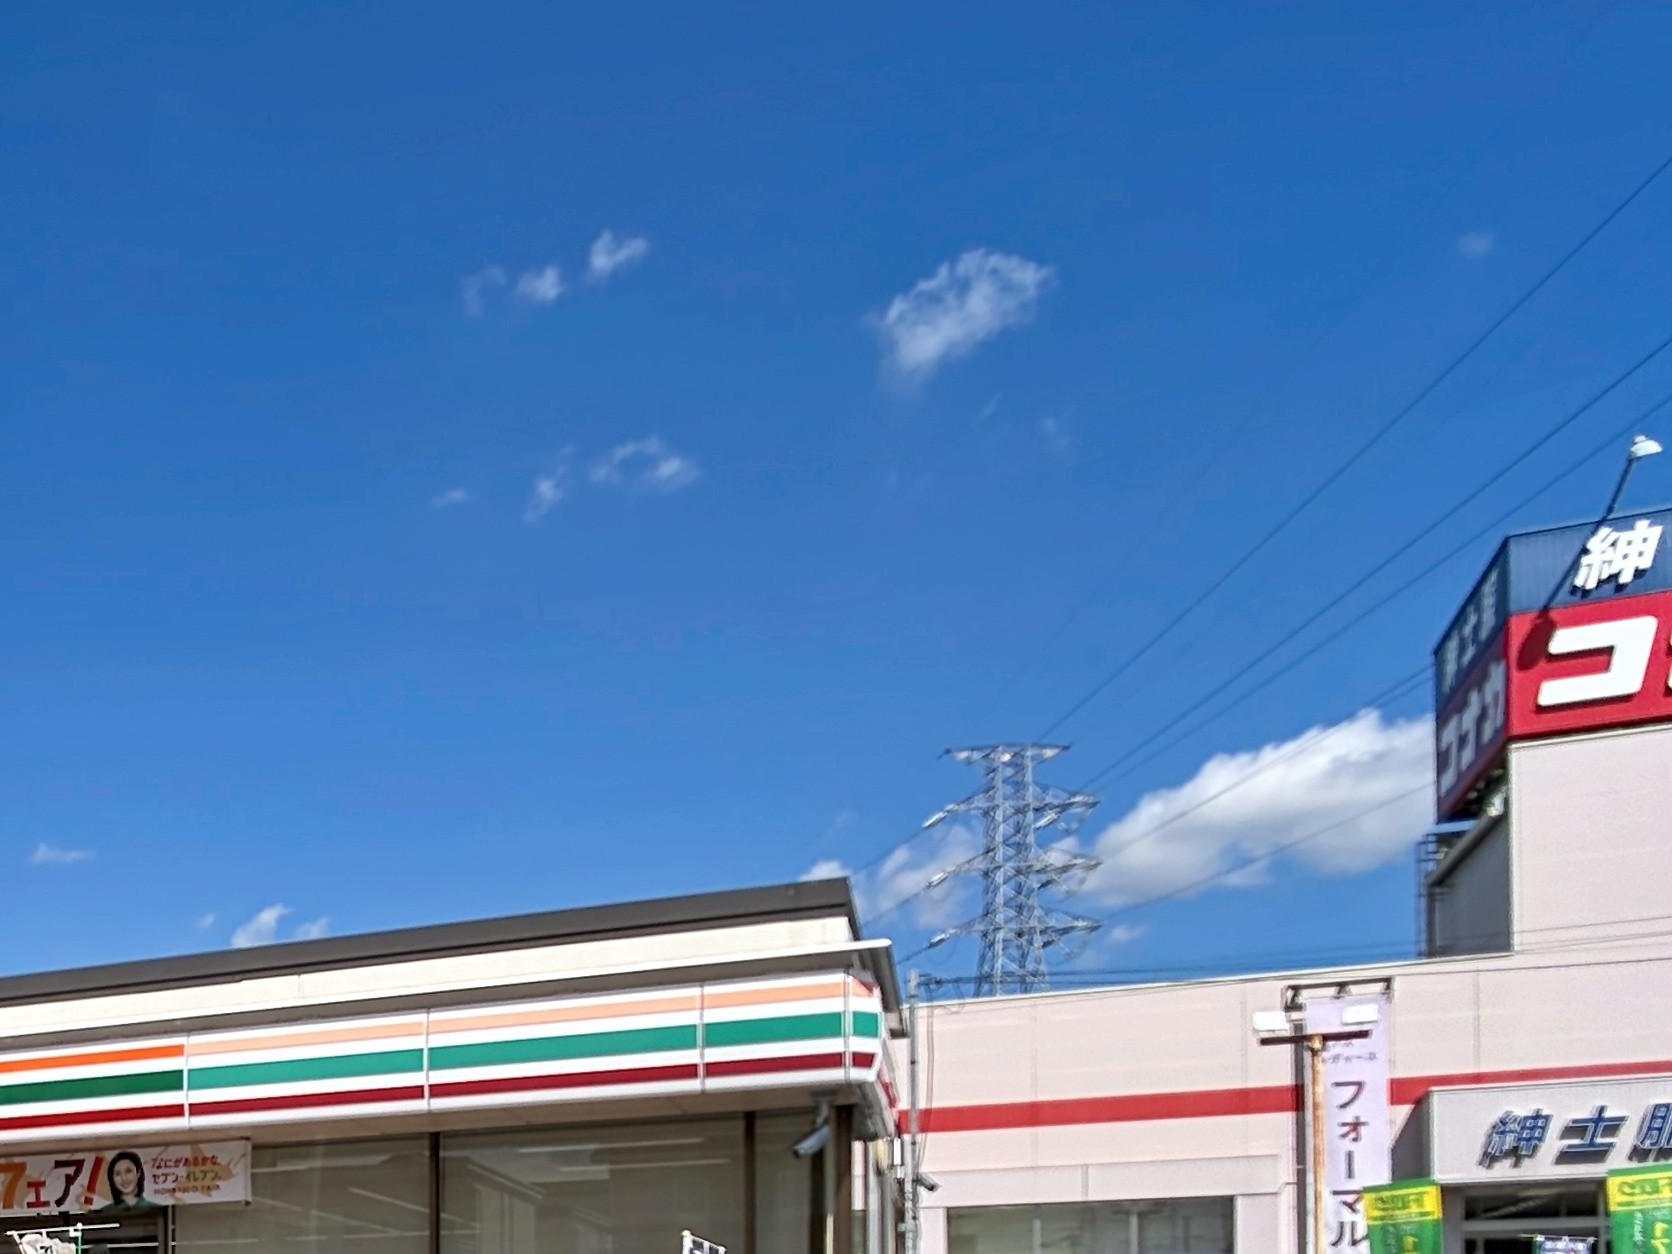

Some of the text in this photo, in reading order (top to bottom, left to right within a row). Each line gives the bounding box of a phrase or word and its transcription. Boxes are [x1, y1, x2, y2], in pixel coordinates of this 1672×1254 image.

[1573, 519, 1662, 590] 紳
[1538, 615, 1672, 706] コ
[1331, 1080, 1370, 1248] フォーマル
